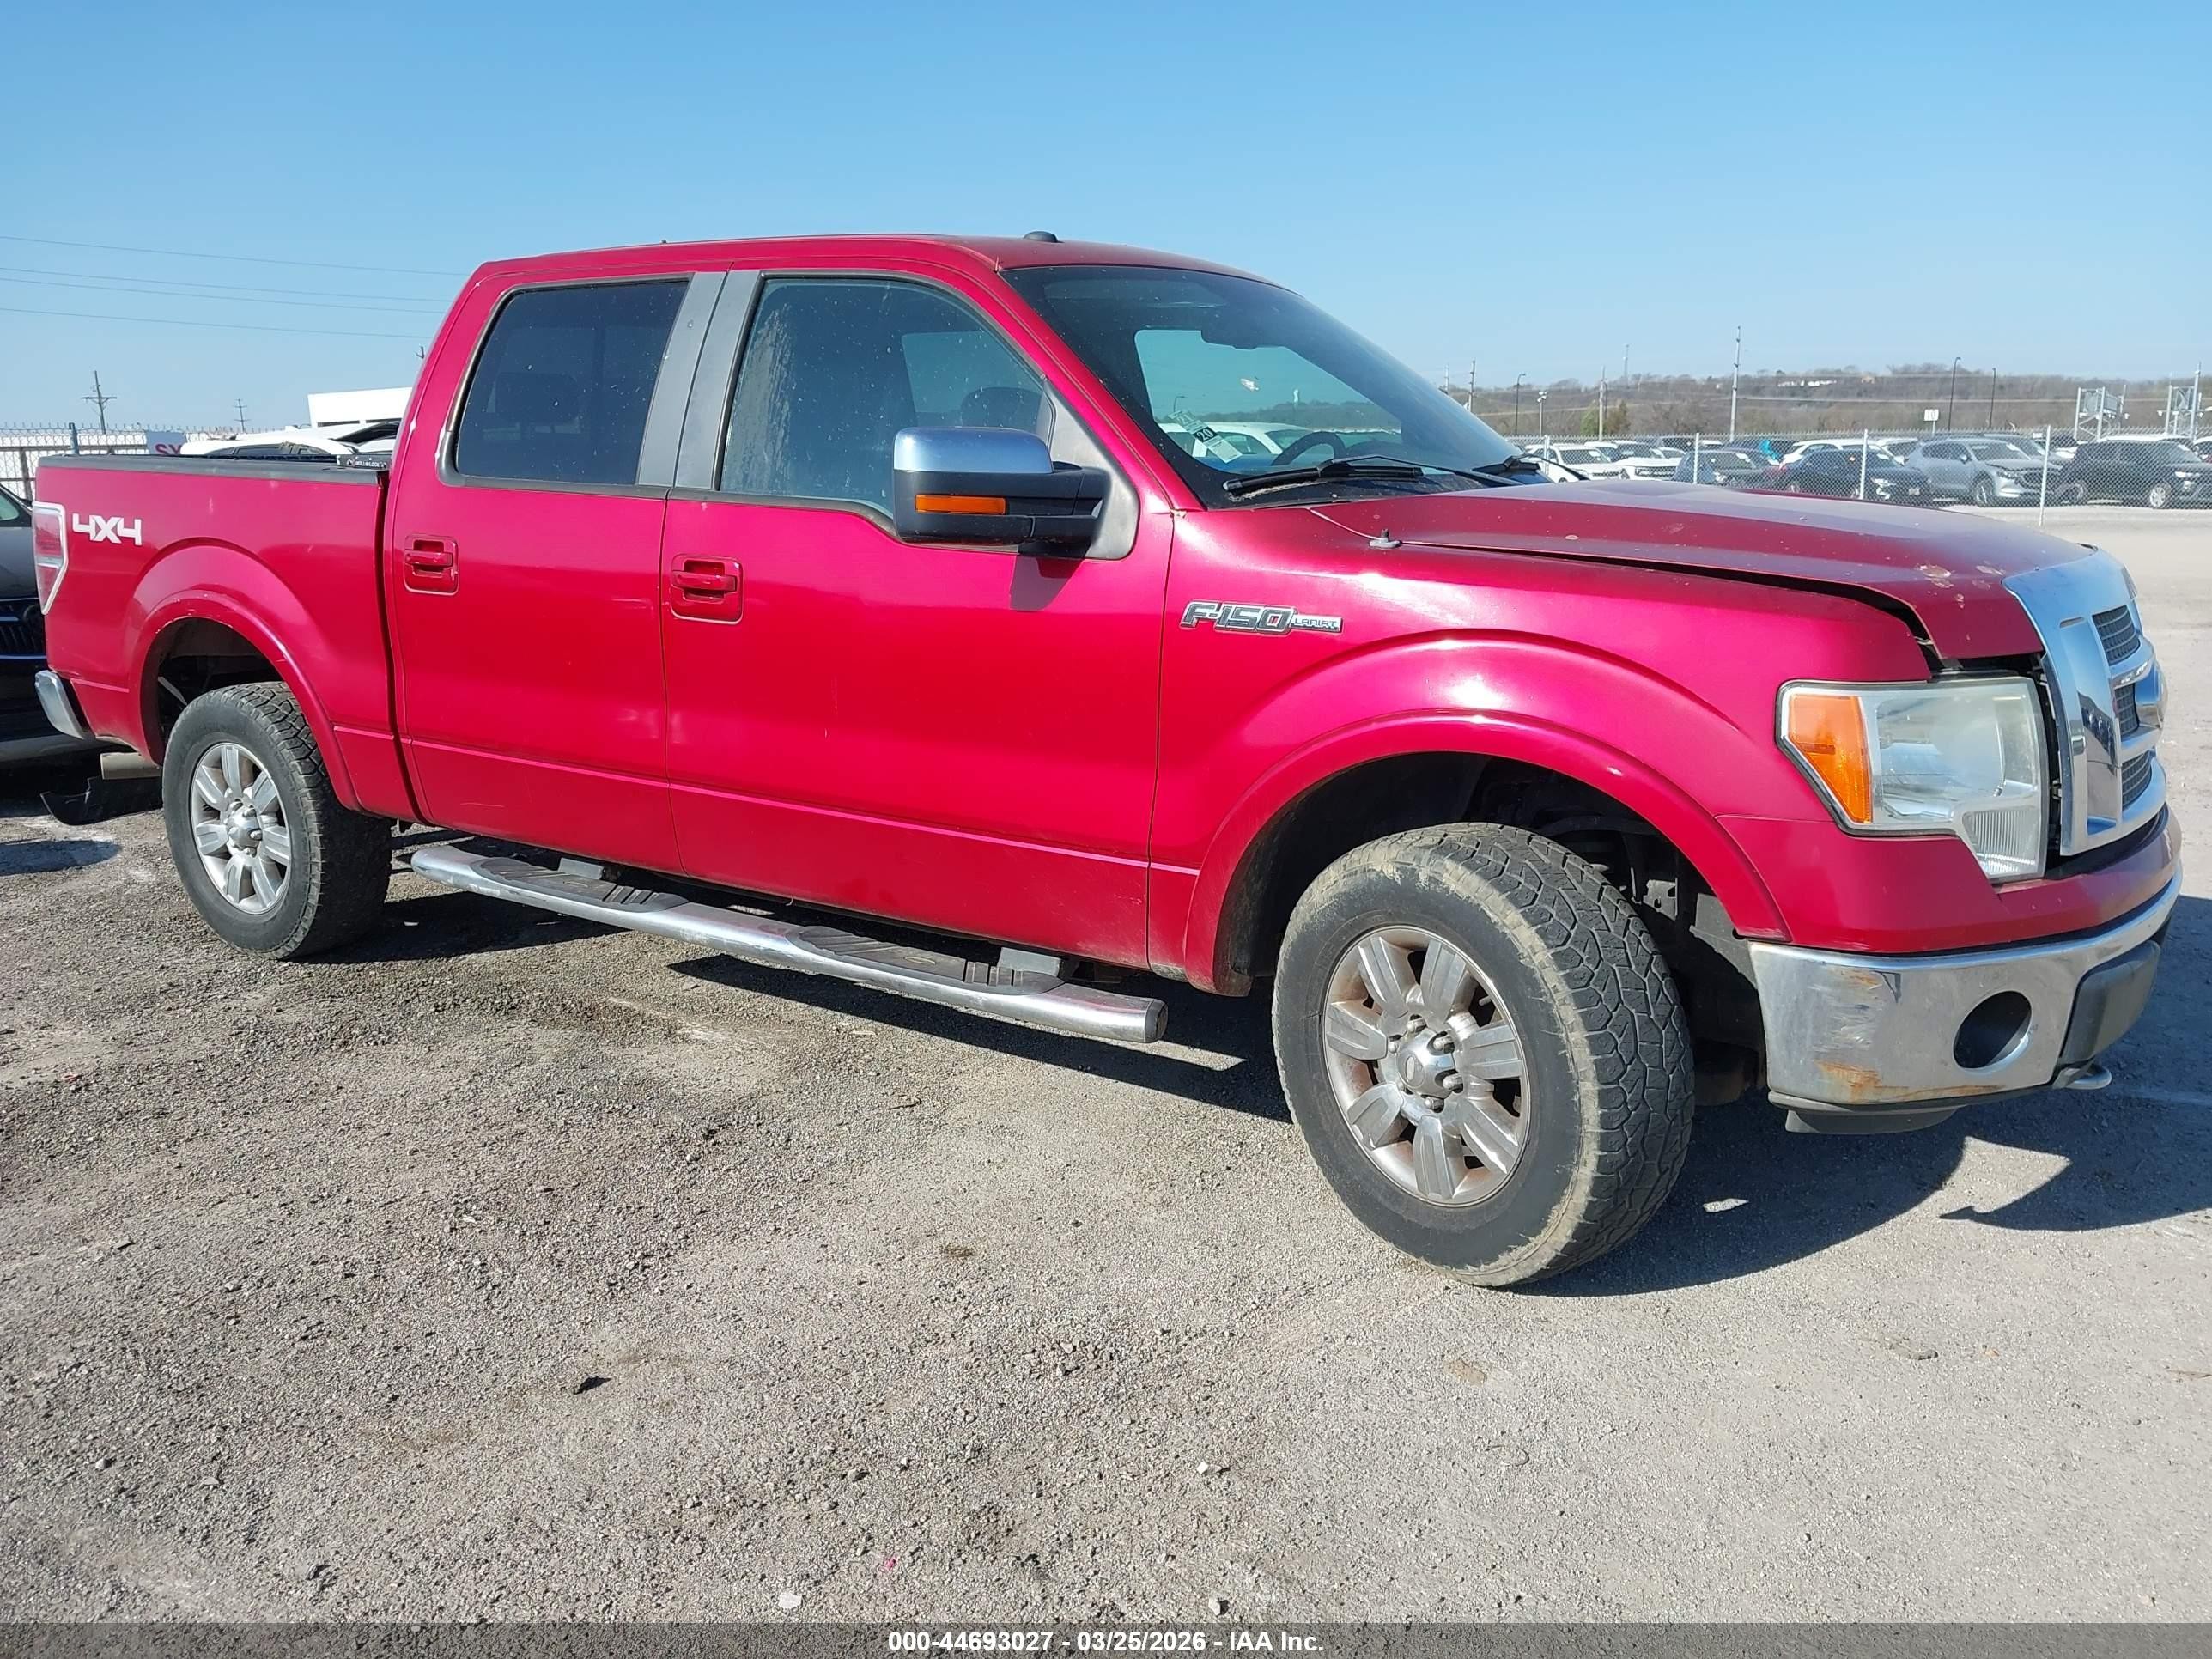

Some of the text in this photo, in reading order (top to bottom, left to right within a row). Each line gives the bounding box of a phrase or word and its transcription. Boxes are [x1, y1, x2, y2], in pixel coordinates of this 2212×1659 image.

[1196, 428, 1215, 441] 20
[1181, 601, 1340, 634] F-150 LARIAT
